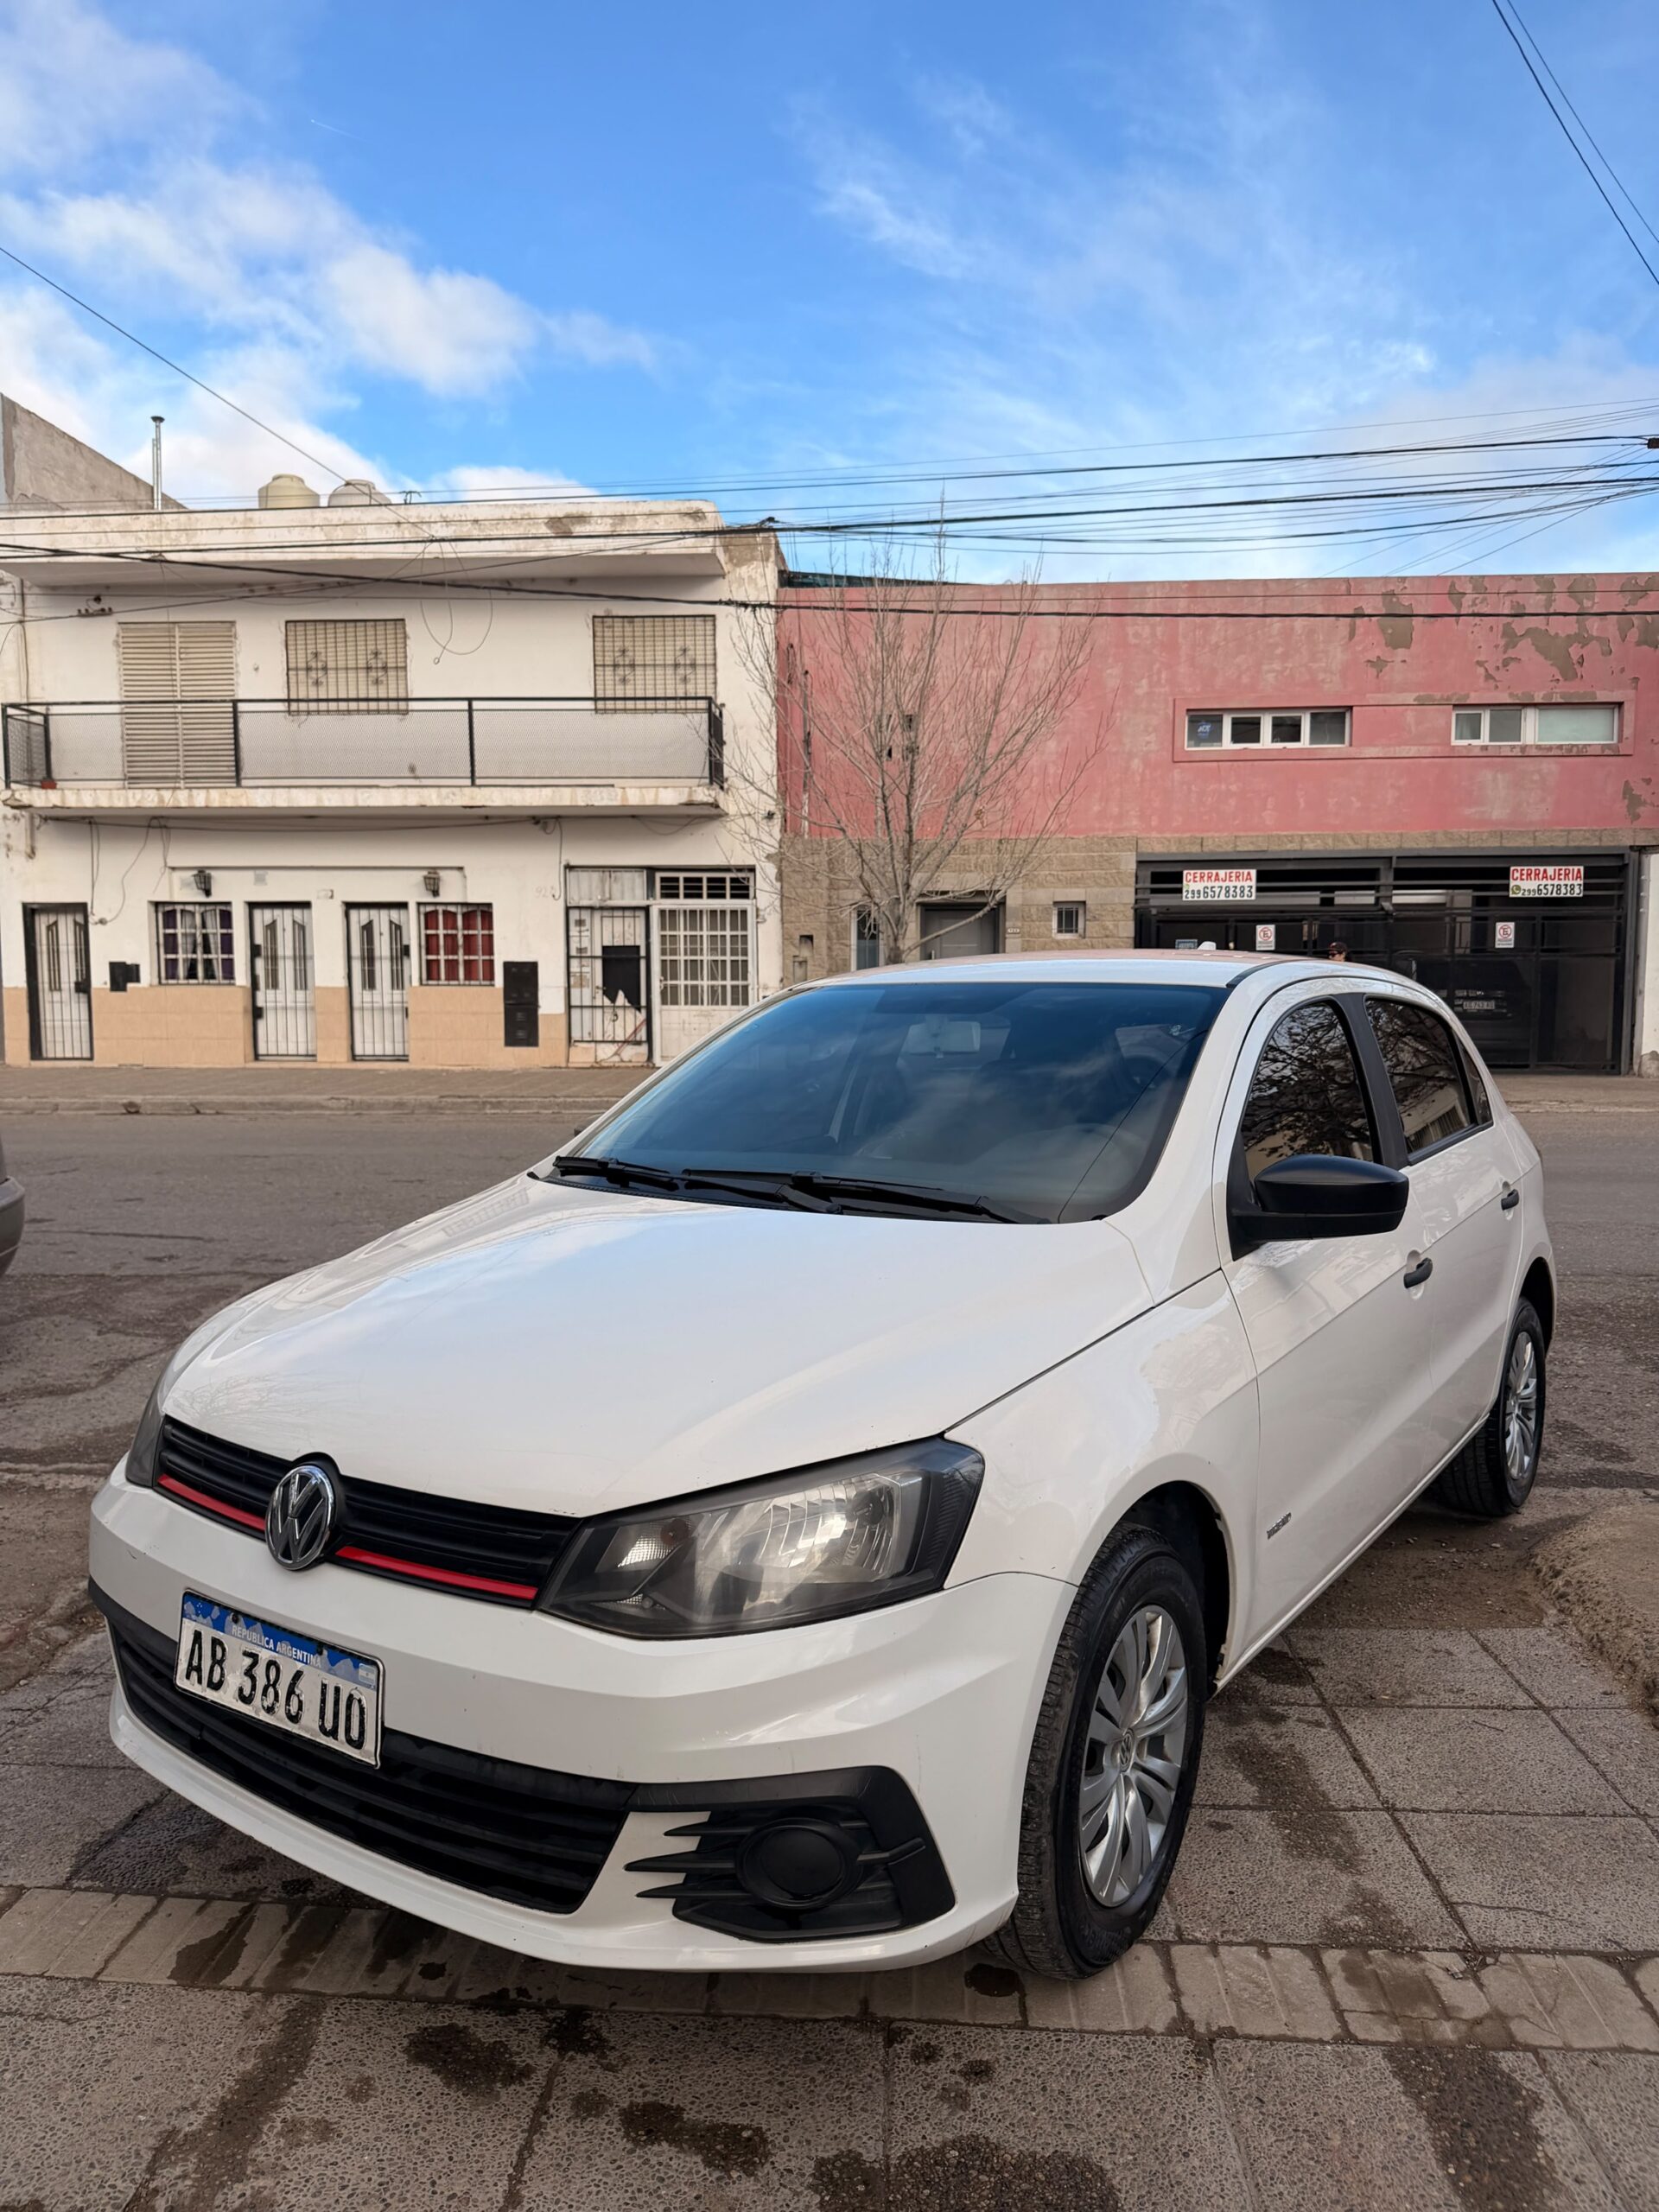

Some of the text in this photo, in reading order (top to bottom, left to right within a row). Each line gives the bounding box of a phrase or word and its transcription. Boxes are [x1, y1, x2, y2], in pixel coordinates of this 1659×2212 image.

[1185, 871, 1253, 883] CERRAJERIA
[1510, 868, 1582, 881] CERRAJERIA
[1185, 886, 1253, 899] 2996578383
[1521, 883, 1582, 896] 2996578383
[265, 1465, 334, 1571] VW
[232, 1624, 321, 1669] REPUBLICA ARGENTINA
[185, 1630, 367, 1751] AB 386 UO
